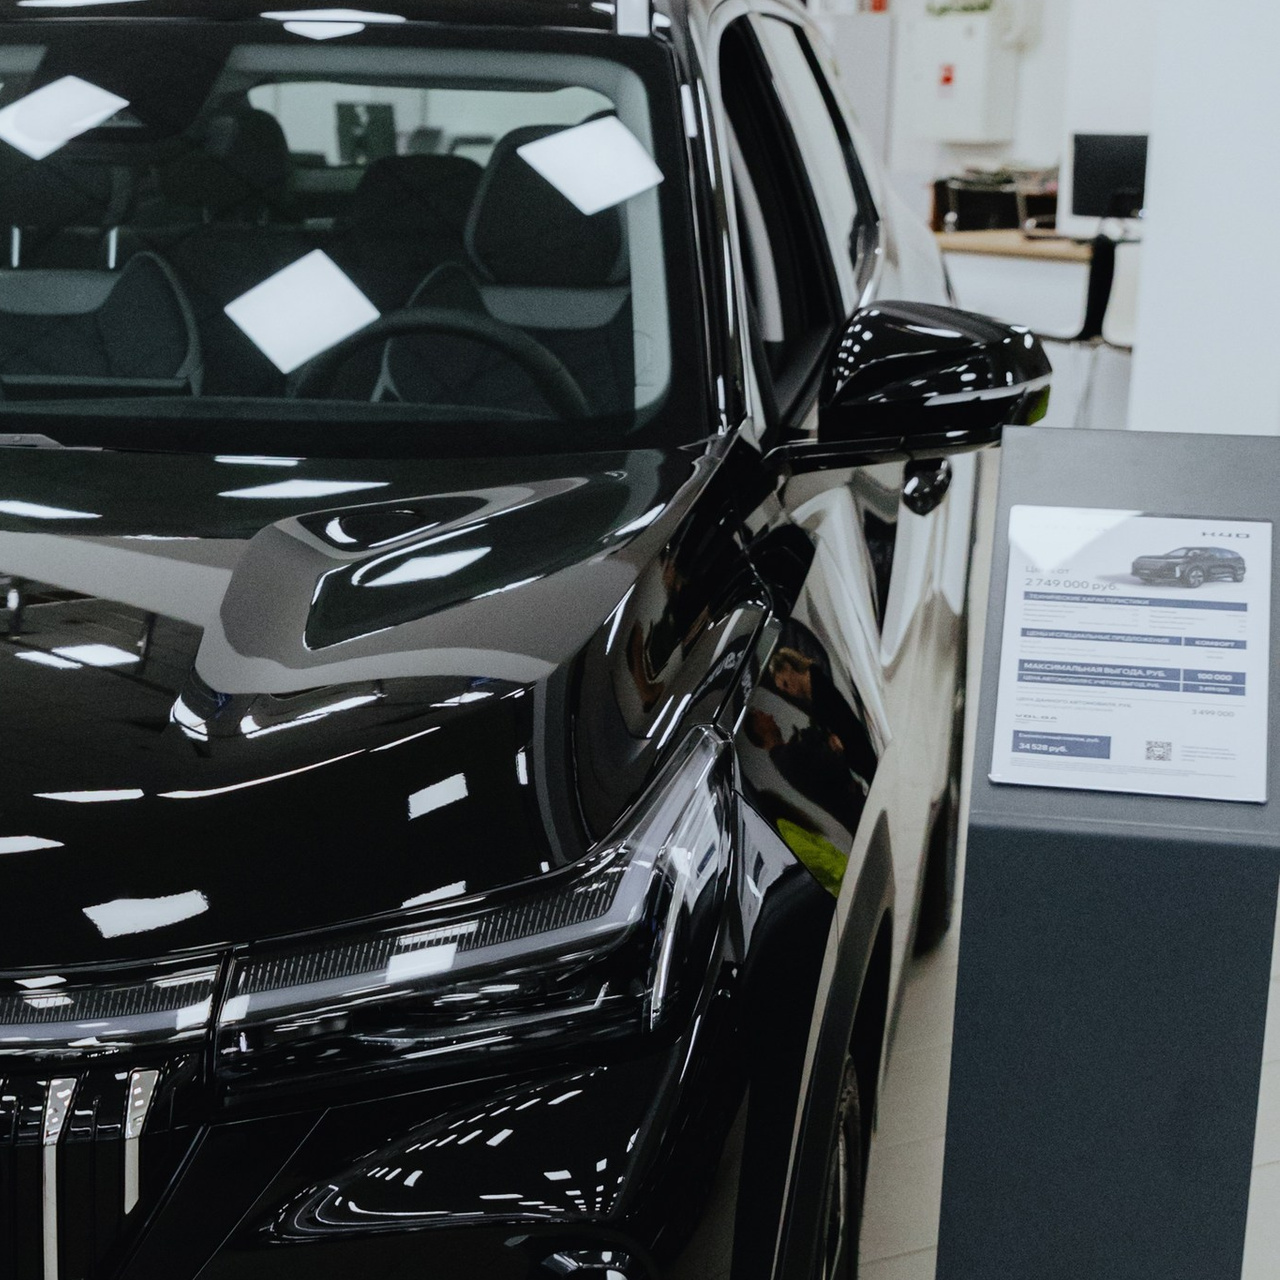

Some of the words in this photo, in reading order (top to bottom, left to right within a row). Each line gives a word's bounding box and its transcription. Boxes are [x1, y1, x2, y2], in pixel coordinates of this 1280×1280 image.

[1025, 578, 1033, 587] 2
[1035, 579, 1061, 588] 749
[1063, 580, 1089, 589] 000
[1092, 583, 1120, 592] руб.
[1024, 662, 1102, 673] МАКСИМАЛЬНАЯ
